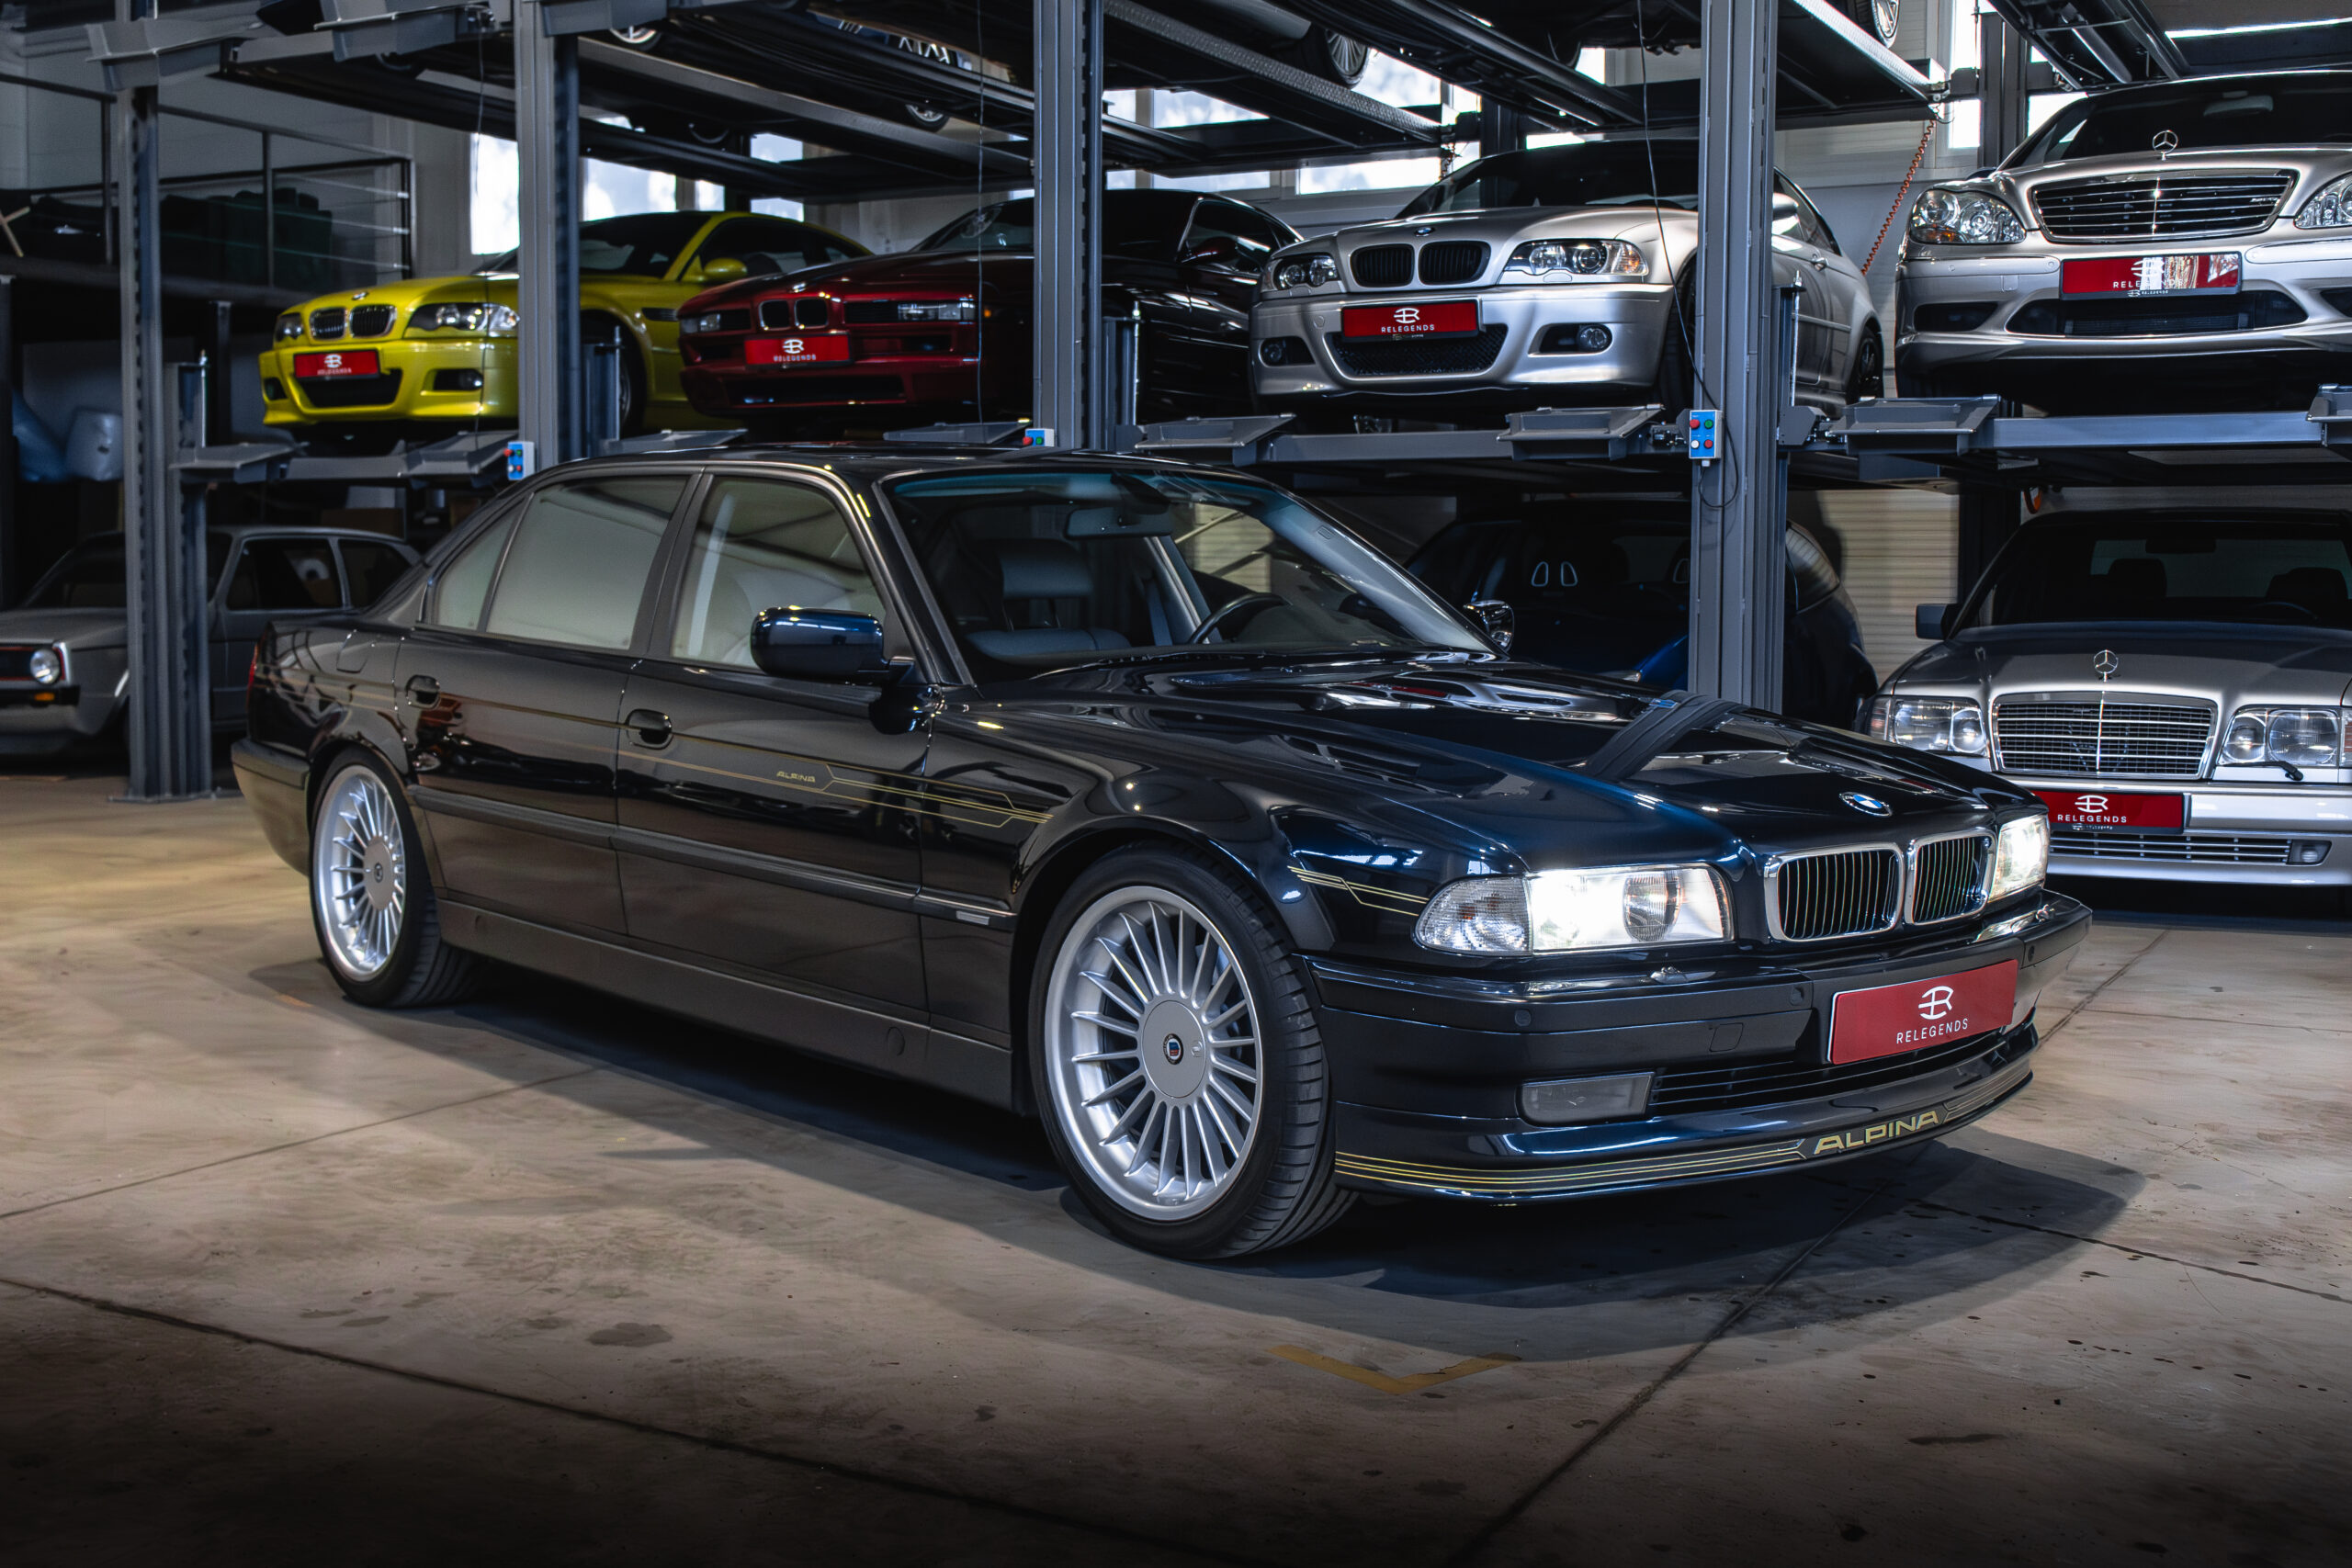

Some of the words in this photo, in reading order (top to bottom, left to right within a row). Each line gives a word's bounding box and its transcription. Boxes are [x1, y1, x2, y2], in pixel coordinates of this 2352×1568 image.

[1381, 323, 1435, 333] RELEGENDS
[775, 771, 816, 783] ALPINA
[2057, 814, 2128, 824] RELEGENDS
[1896, 1018, 1969, 1044] RELEGENDS
[1813, 1110, 1939, 1156] ALPINA
